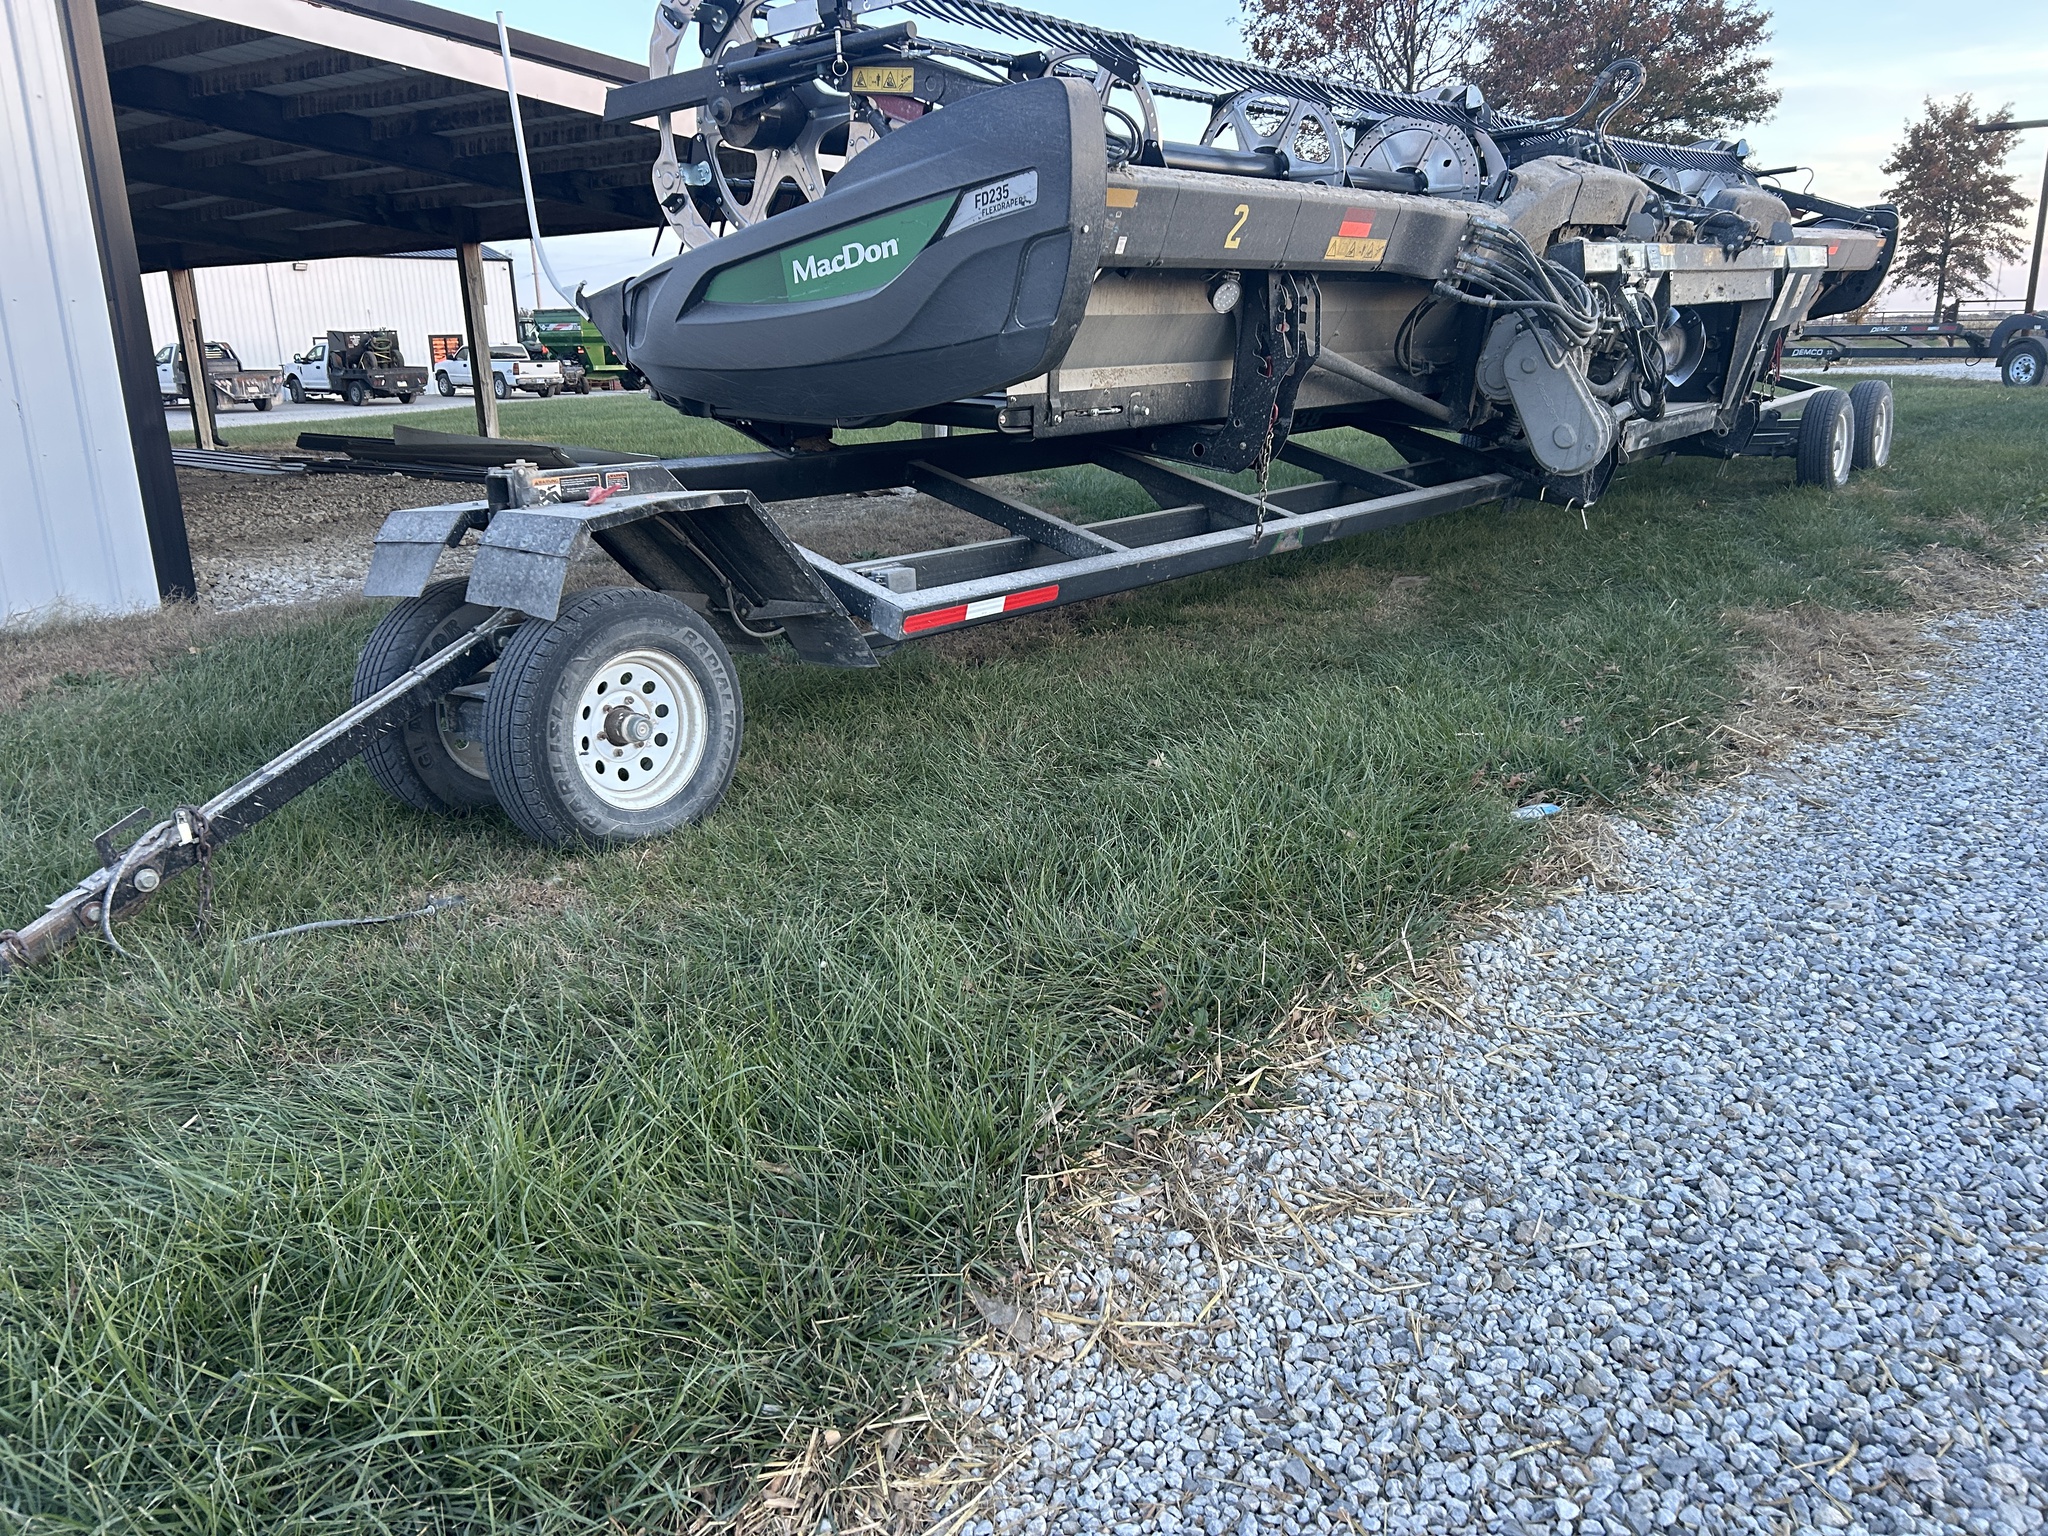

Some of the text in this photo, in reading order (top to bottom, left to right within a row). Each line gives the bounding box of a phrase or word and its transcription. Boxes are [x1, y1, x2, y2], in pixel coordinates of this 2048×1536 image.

[974, 183, 1009, 209] FD235
[1224, 204, 1250, 249] 2
[792, 238, 899, 284] MacDon
[1791, 348, 1823, 357] DEMCO
[681, 628, 737, 705] RADIAL
[549, 675, 602, 830] CARLISLE
